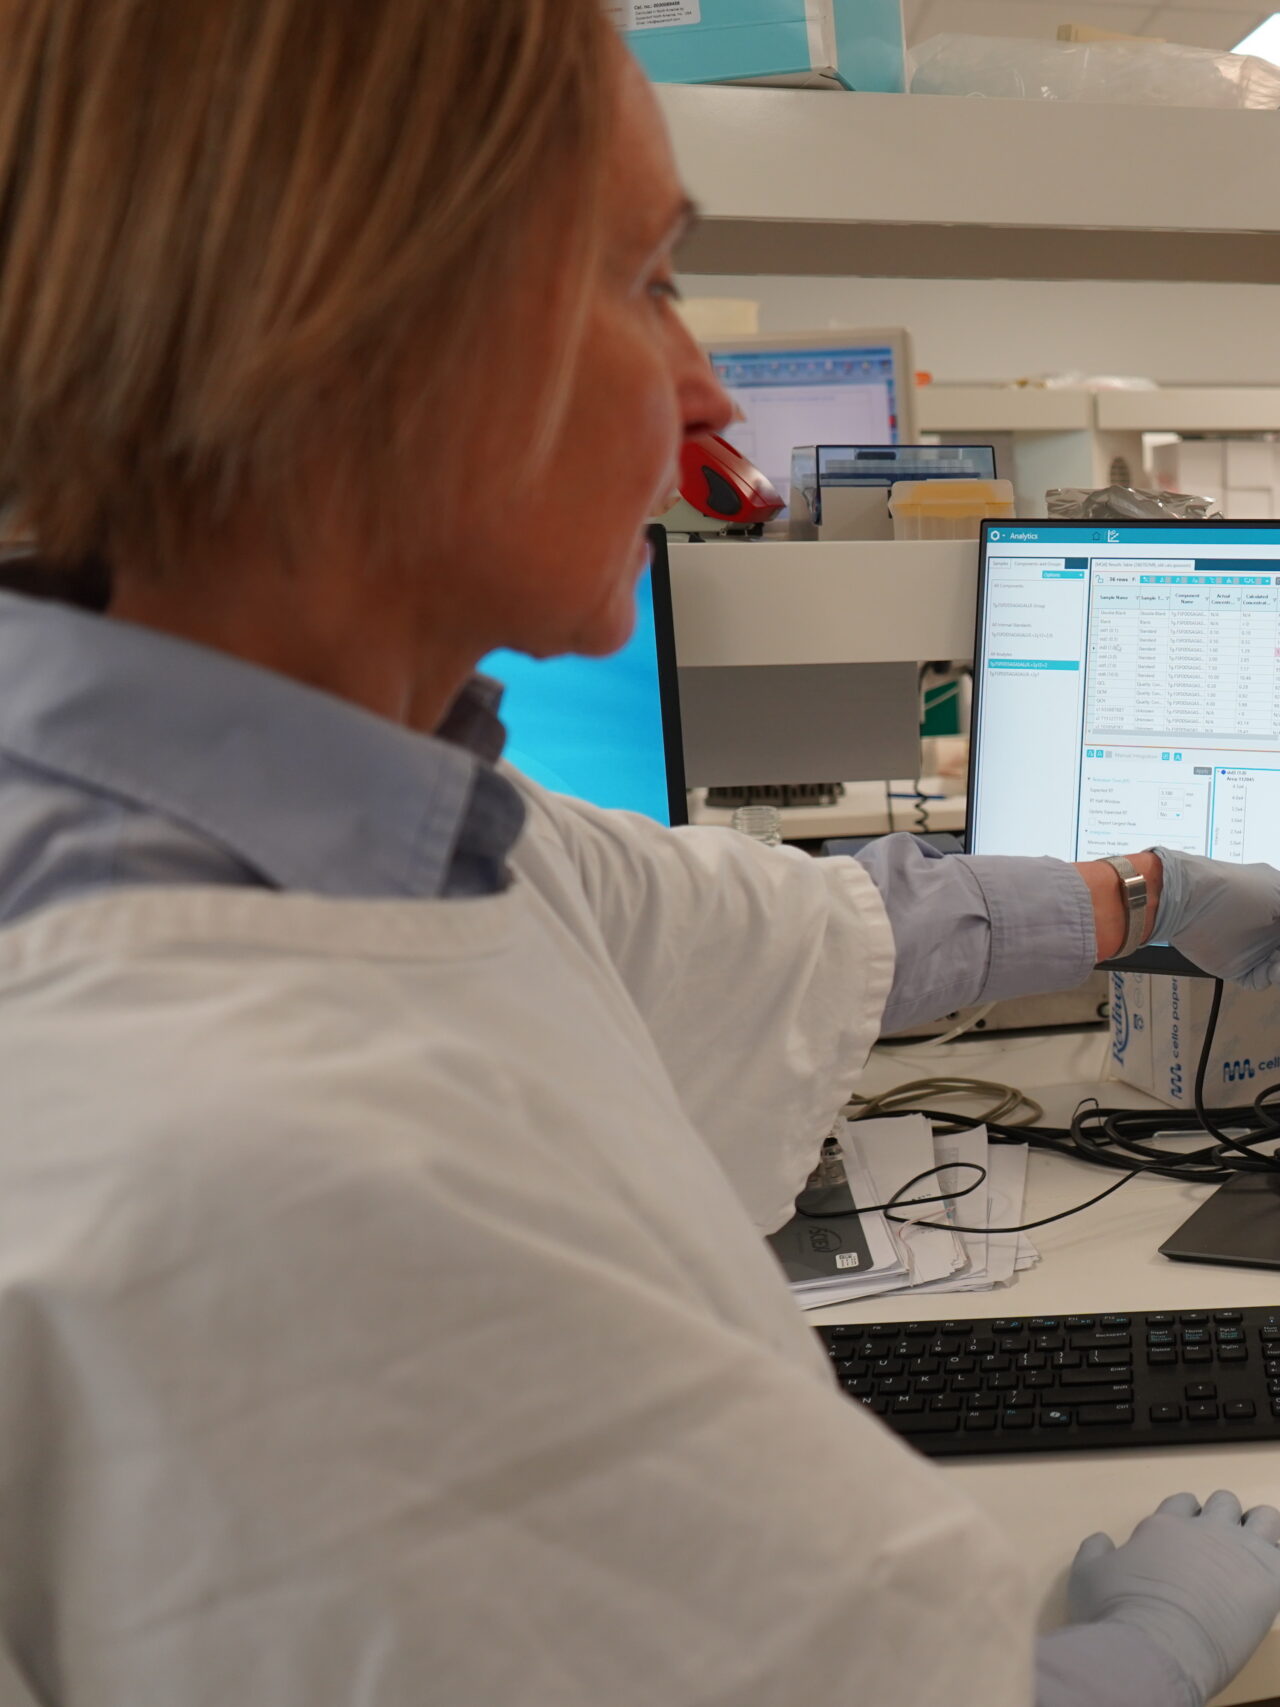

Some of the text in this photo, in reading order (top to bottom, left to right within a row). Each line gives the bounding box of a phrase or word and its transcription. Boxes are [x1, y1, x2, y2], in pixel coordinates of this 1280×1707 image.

[1010, 532, 1038, 541] Analytics
[1171, 975, 1180, 1058] cello paper
